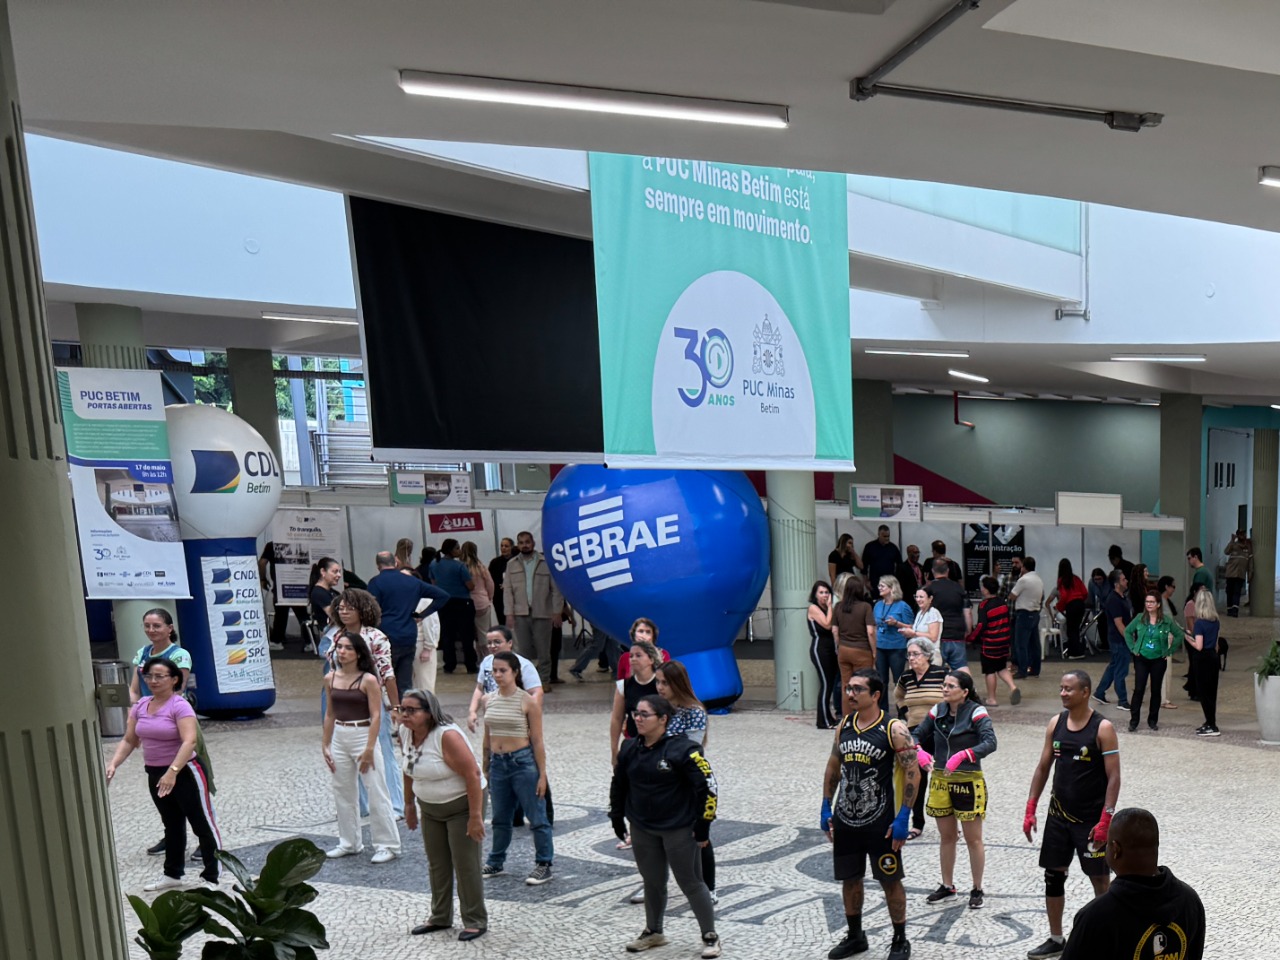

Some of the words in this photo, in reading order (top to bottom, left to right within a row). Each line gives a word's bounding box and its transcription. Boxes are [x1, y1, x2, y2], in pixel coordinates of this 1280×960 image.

[656, 157, 689, 179] PUC
[692, 161, 739, 193] Minas
[741, 169, 782, 203] Betim
[784, 186, 811, 211] está
[645, 187, 704, 222] sempre
[707, 202, 731, 226] em
[733, 208, 813, 244] movimento.
[673, 327, 734, 408] 30
[742, 379, 764, 396] PUC
[766, 382, 795, 399] Minas
[80, 390, 104, 401] PUC
[105, 391, 141, 402] BETIM
[707, 393, 735, 406] ANOS
[87, 402, 117, 410] PORTAS
[118, 403, 152, 411] ABERTAS
[760, 402, 780, 414] Betim
[244, 450, 279, 477] CDL
[246, 481, 271, 494] Betim
[452, 517, 476, 527] UAI
[551, 513, 680, 572] SEBRAE
[974, 544, 1022, 553] Admnistração
[233, 570, 258, 581] CNDL
[235, 588, 259, 600] FCDL
[243, 609, 260, 620] CDL
[246, 629, 263, 639] CDL
[248, 647, 266, 658] SPC
